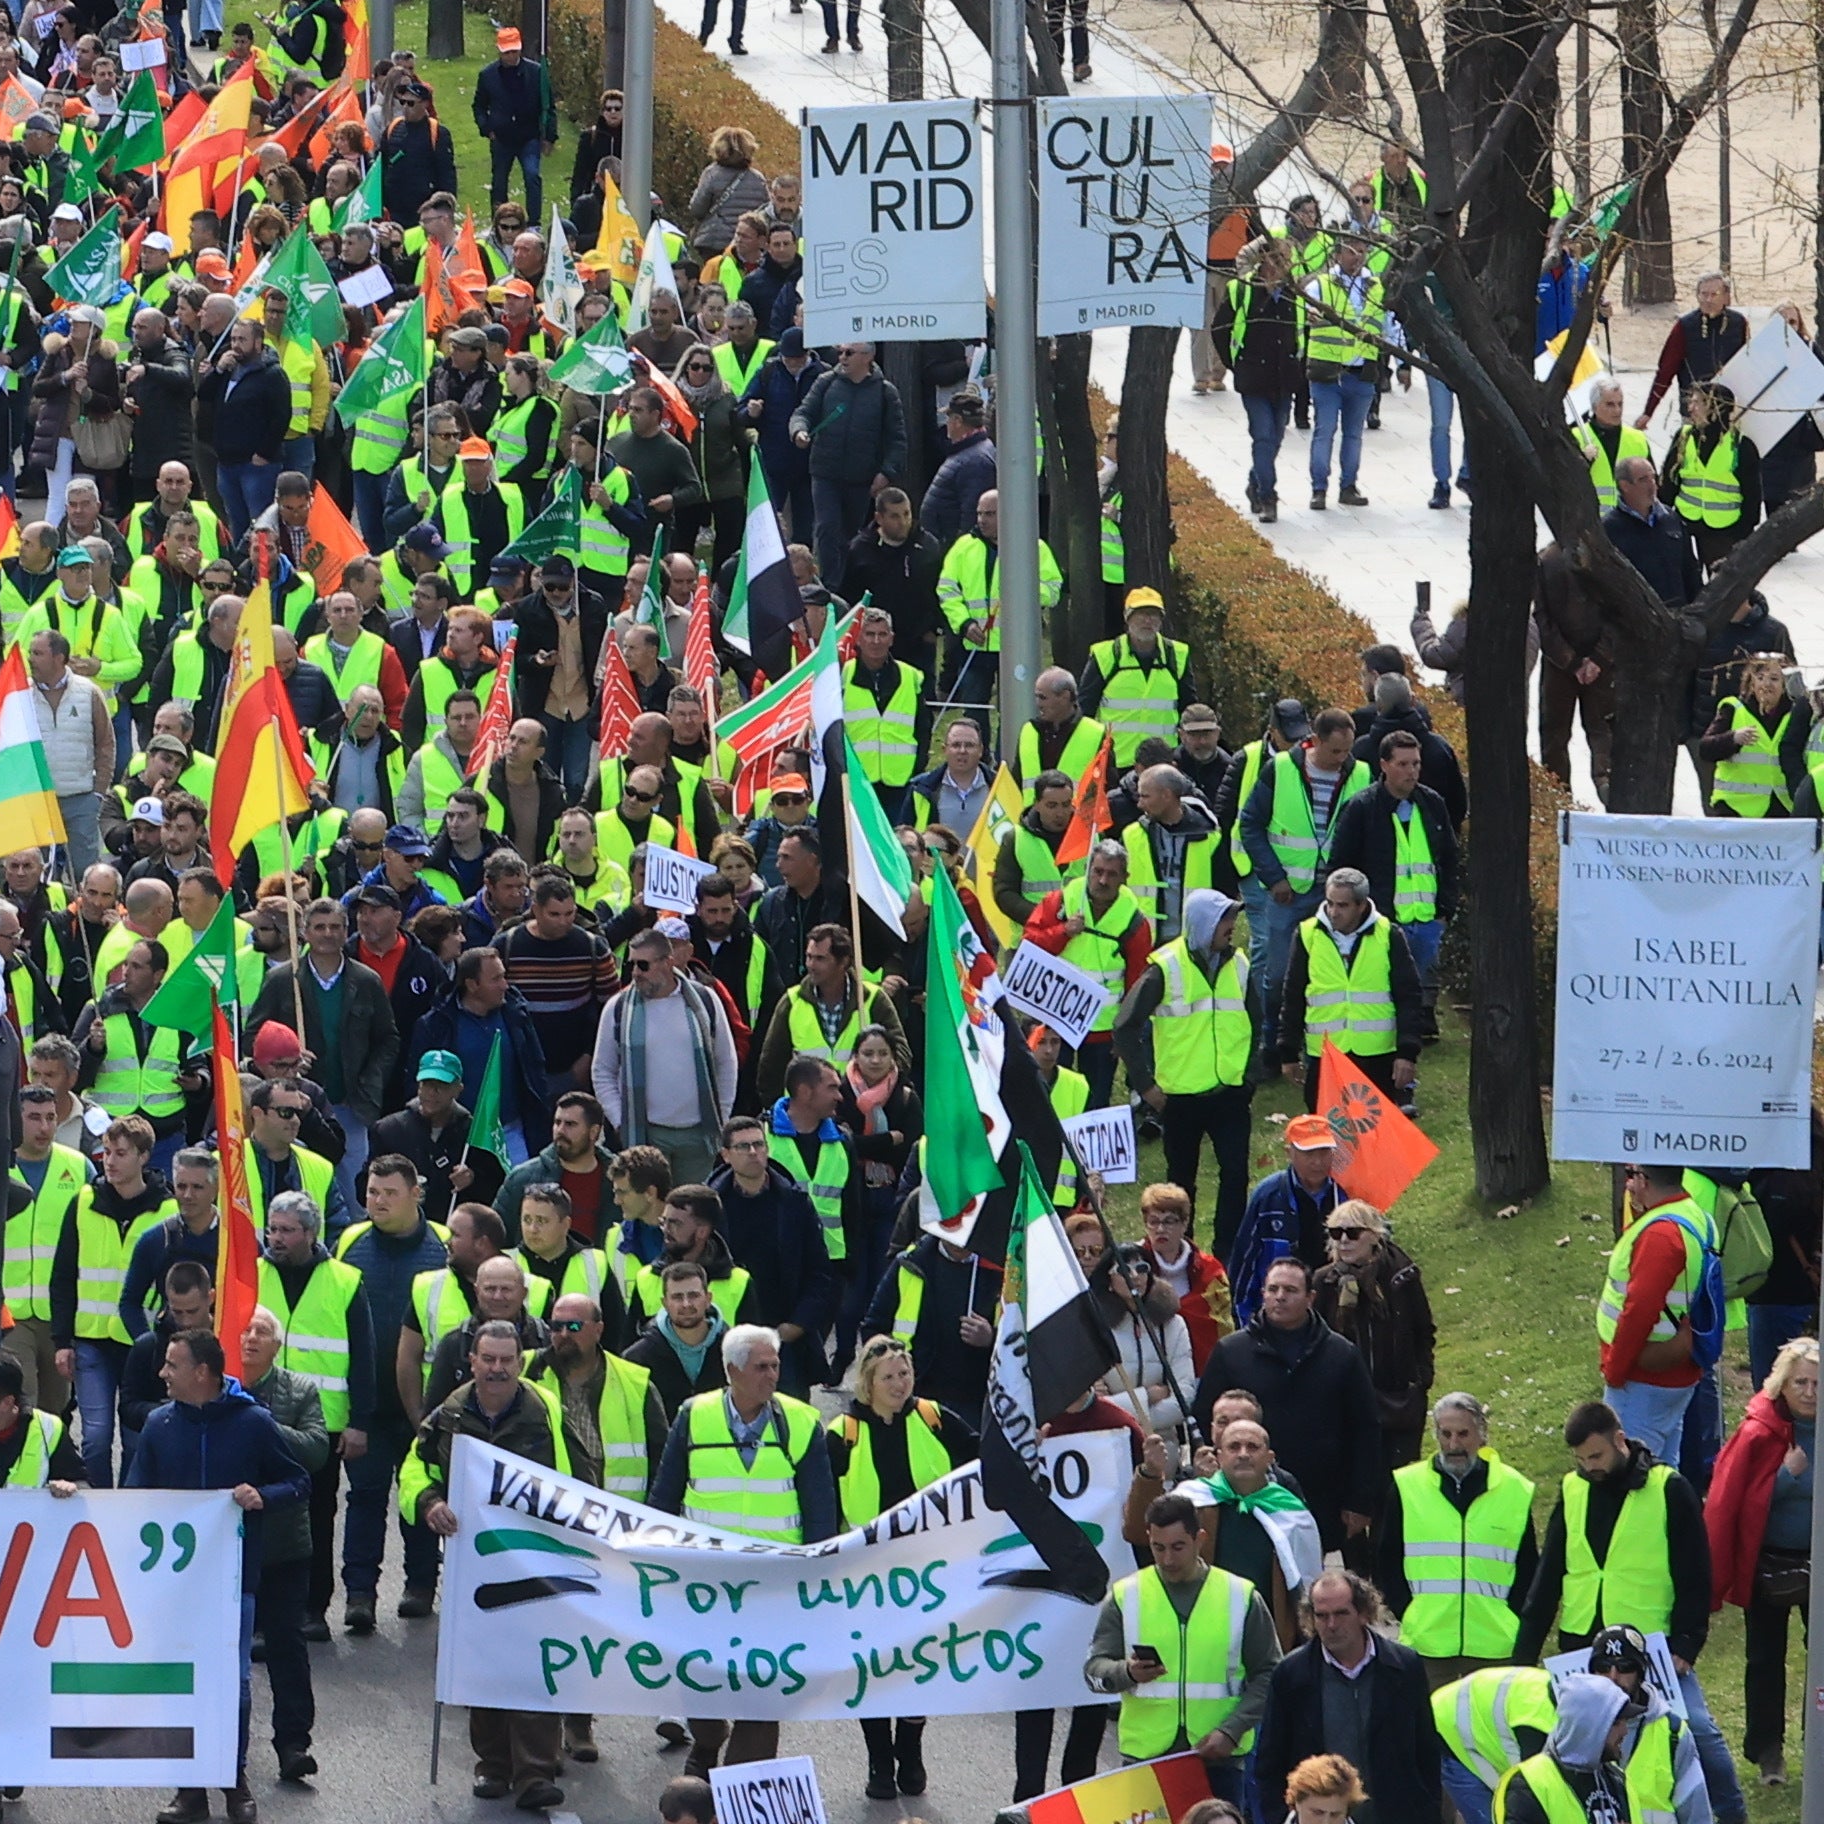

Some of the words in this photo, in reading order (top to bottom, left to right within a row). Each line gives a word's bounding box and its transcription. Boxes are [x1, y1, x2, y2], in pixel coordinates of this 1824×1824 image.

[809, 117, 972, 178] MAD
[1047, 115, 1175, 173] CUL
[870, 177, 974, 233] RID
[1066, 172, 1150, 225] TU
[813, 238, 889, 300] ES
[1106, 231, 1195, 287] RA
[872, 312, 939, 330] MADRID
[1095, 303, 1157, 321] MADRID
[1596, 838, 1669, 857] MUSEO
[1675, 842, 1788, 862] NACIONAL
[1572, 862, 1811, 888] THYSSEN-BORNEMISZA
[1634, 937, 1747, 967] ISABEL
[1007, 958, 1103, 1036] ¡JUSTICIA!
[1570, 973, 1803, 1007] QUINTANILLA
[1654, 1132, 1747, 1153] MADRID
[631, 1561, 759, 1617] Por
[798, 1559, 949, 1613] unos
[539, 1635, 807, 1696] precios
[845, 1621, 1044, 1708] justos
